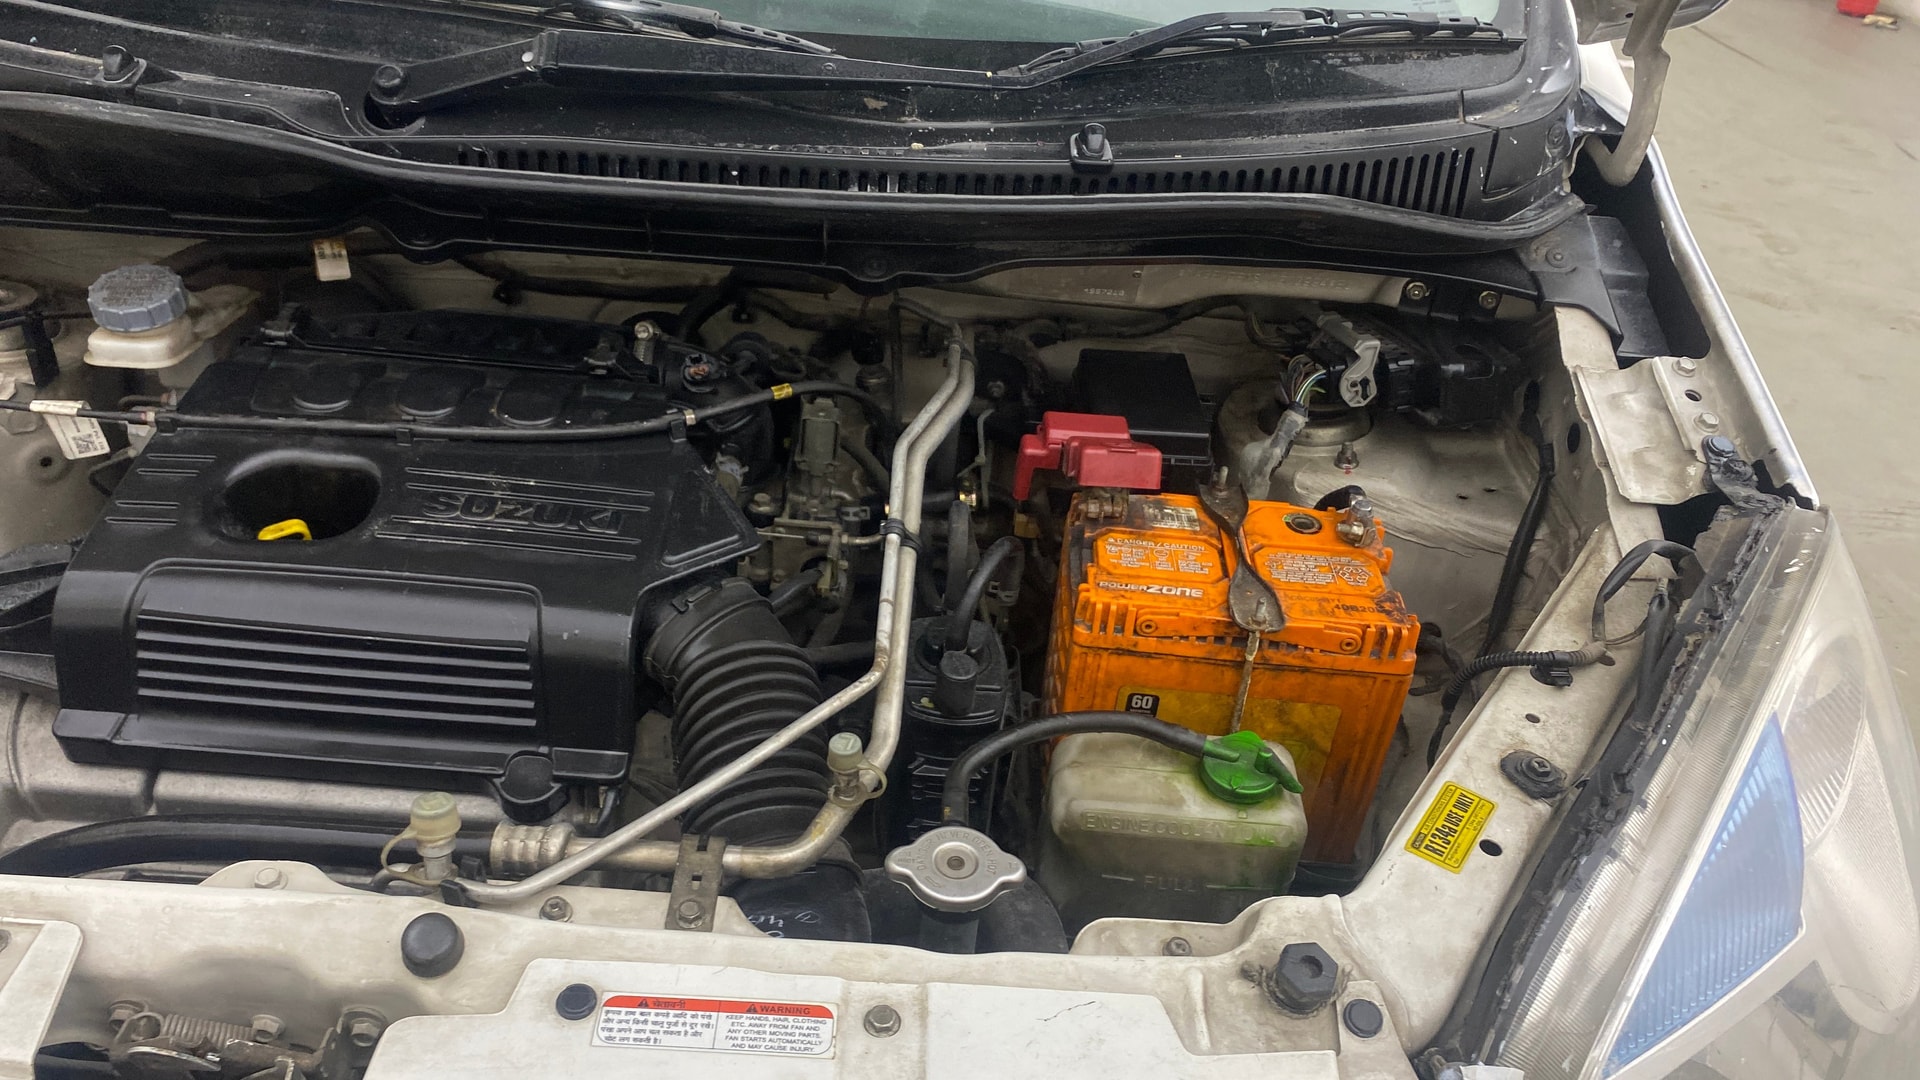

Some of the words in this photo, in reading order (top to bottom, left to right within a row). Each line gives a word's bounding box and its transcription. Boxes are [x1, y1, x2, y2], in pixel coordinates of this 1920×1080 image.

[422, 494, 625, 534] SUZUKI
[1117, 538, 1155, 547] DANGER
[1162, 542, 1205, 552] CAUTION
[1131, 695, 1153, 709] 60
[1452, 792, 1476, 813] ONLY
[1085, 813, 1151, 834] ENGINE
[1444, 809, 1465, 828] USE
[935, 831, 970, 841] NEVER
[1423, 824, 1458, 857] R134a
[1144, 875, 1197, 892] FULL
[652, 999, 686, 1009] चेतावनी
[760, 1005, 811, 1015] WARNING
[768, 1037, 823, 1046] AUTOMATICALLY
